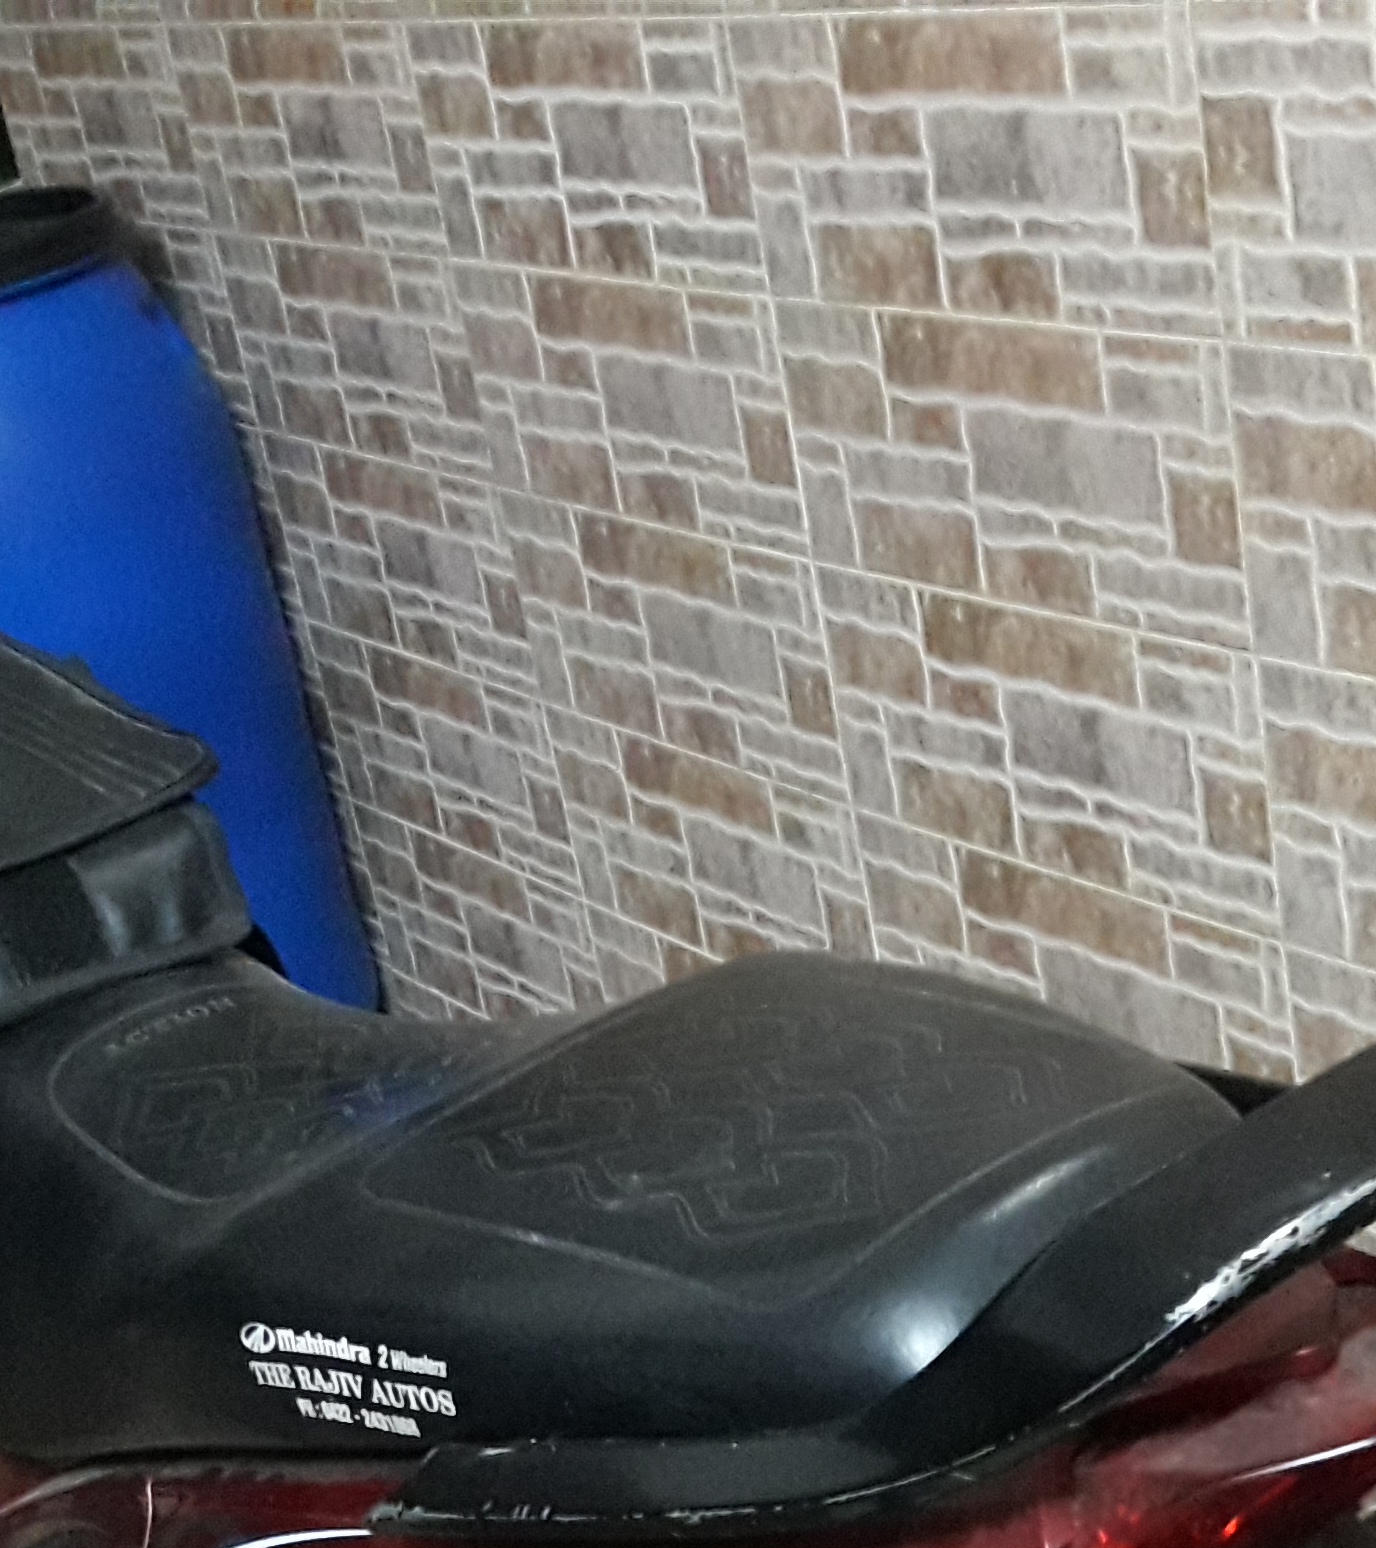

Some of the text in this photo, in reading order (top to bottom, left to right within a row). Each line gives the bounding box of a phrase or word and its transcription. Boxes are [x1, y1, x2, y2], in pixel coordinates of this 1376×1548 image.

[275, 1327, 372, 1365] Mahindra
[377, 1344, 389, 1369] 2
[249, 1360, 456, 1416] THE RAJIV AUTOS
